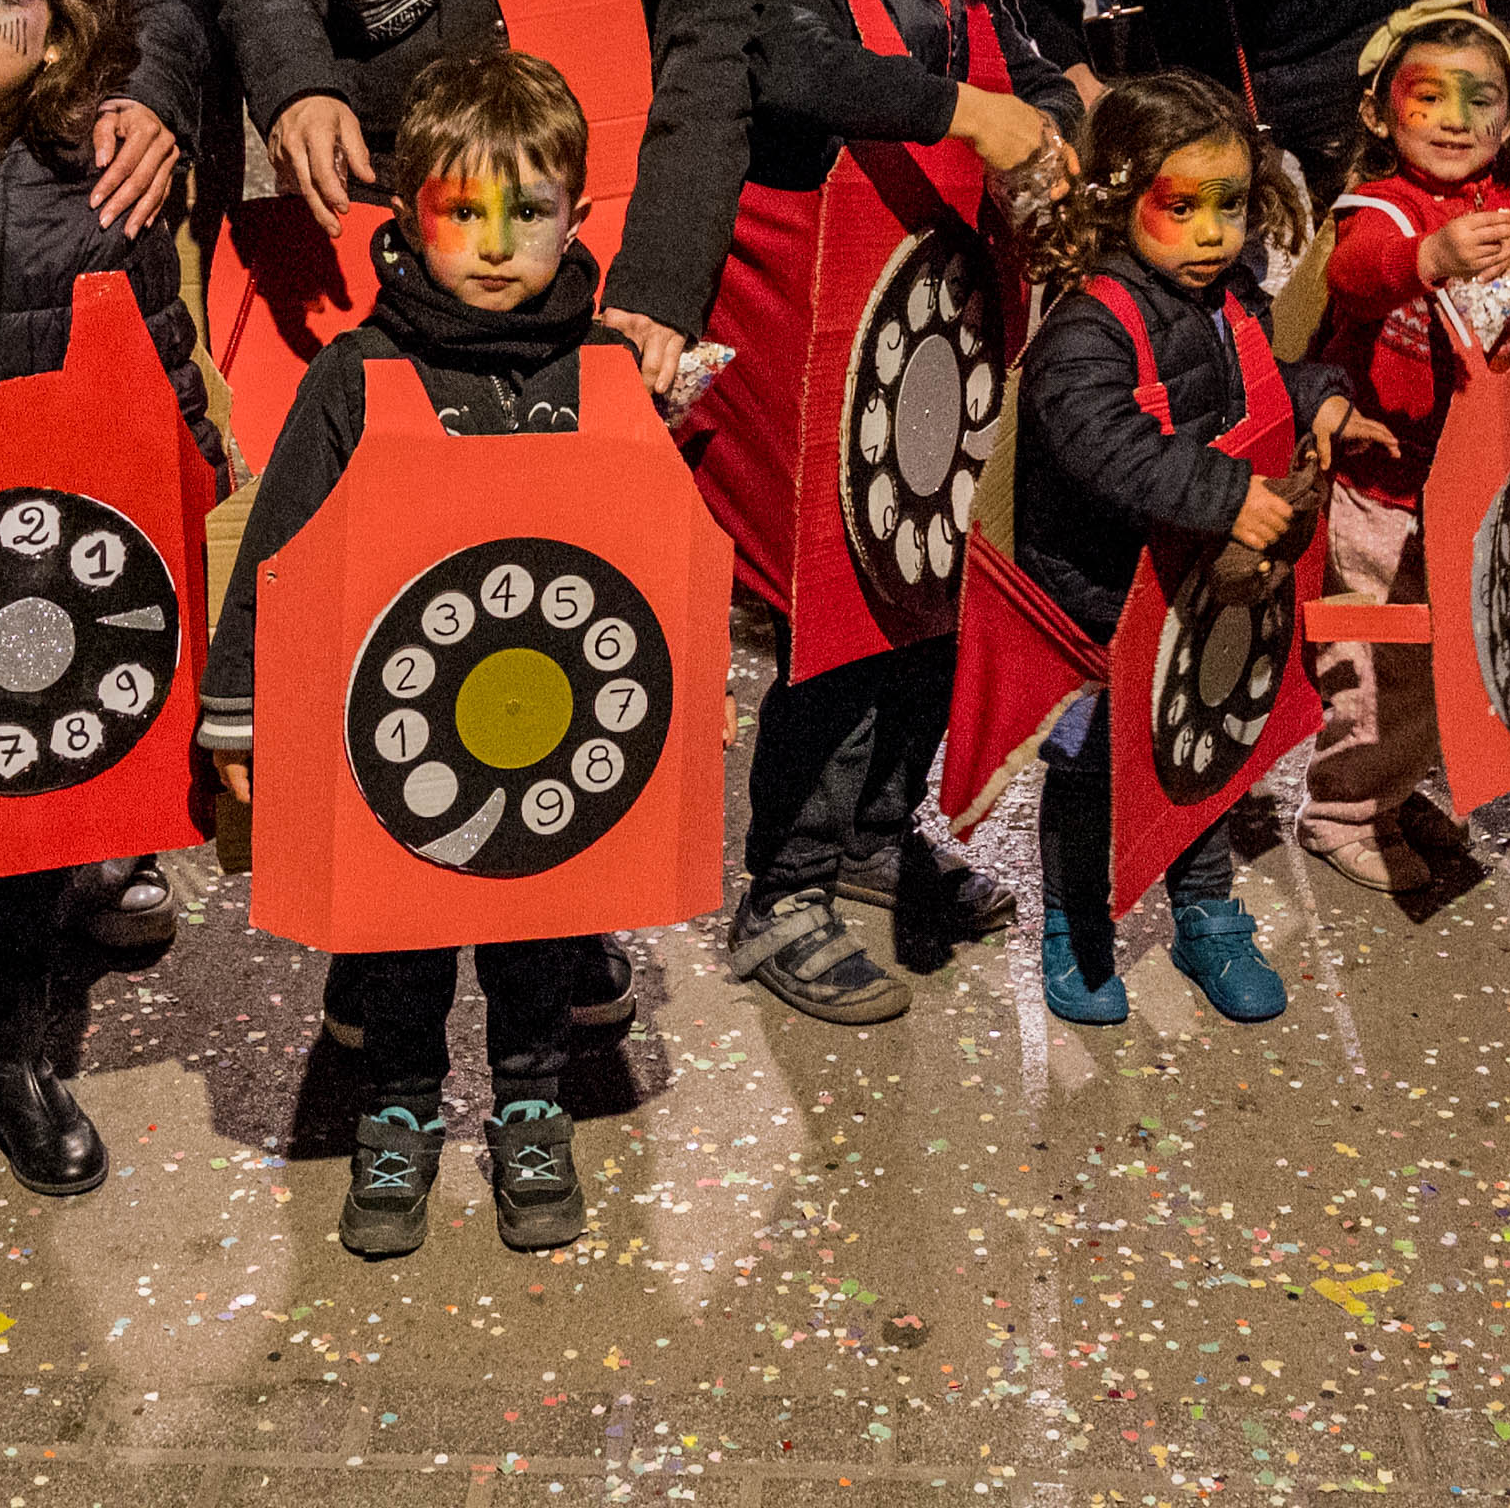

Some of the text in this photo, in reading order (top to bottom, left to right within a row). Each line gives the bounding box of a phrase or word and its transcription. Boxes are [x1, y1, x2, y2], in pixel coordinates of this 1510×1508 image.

[13, 507, 49, 545] 2
[85, 540, 115, 579] 1
[491, 572, 517, 613] 4
[554, 587, 578, 621] 5
[433, 603, 460, 636] 3
[594, 624, 621, 660] 6
[115, 669, 139, 708] 9
[395, 656, 417, 691] 2
[609, 687, 636, 723] 7
[65, 718, 90, 751] 8
[390, 718, 407, 758] 1
[585, 744, 613, 783] 8
[535, 787, 564, 827] 9
